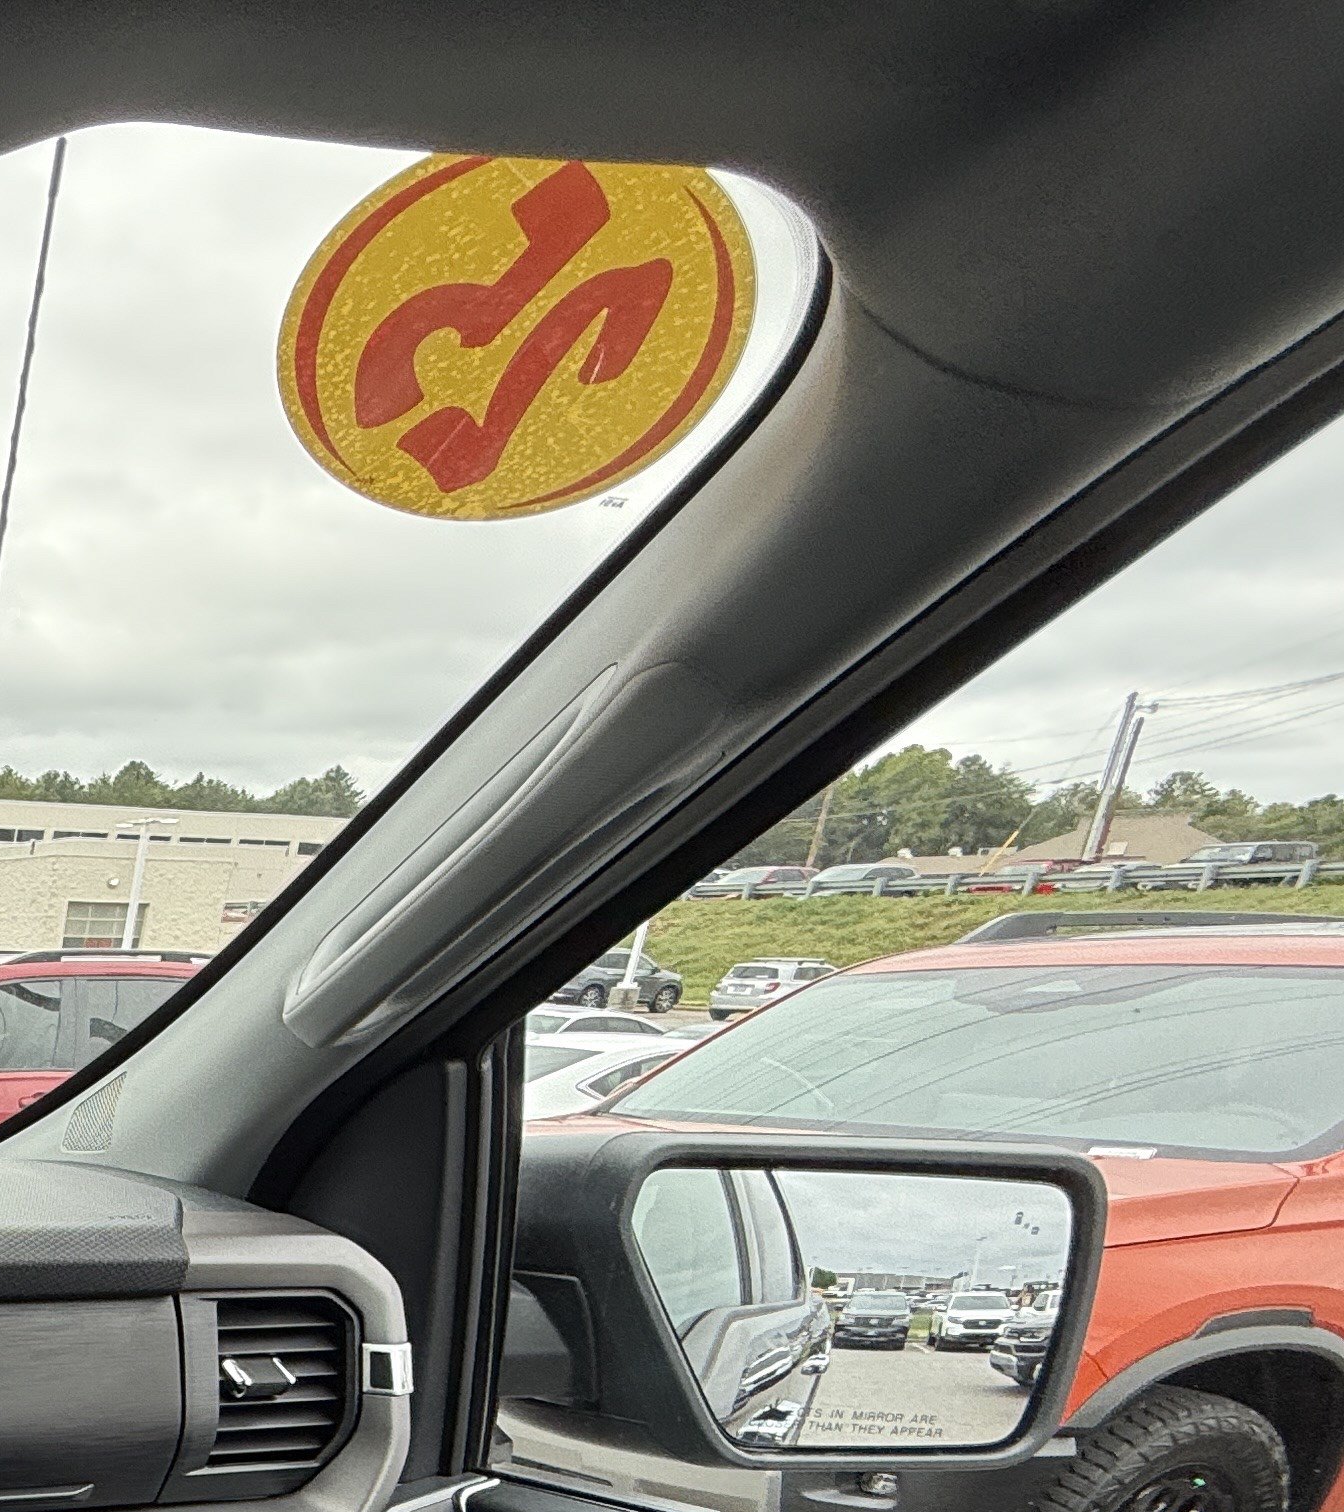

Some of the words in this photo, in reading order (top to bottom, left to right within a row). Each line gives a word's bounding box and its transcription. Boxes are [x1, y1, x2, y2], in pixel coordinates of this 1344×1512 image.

[851, 1410, 905, 1423] MIRROR
[909, 1413, 938, 1425] ARE
[808, 1420, 844, 1432] THAN
[852, 1423, 885, 1435] THEY
[889, 1425, 944, 1438] APPEAR
